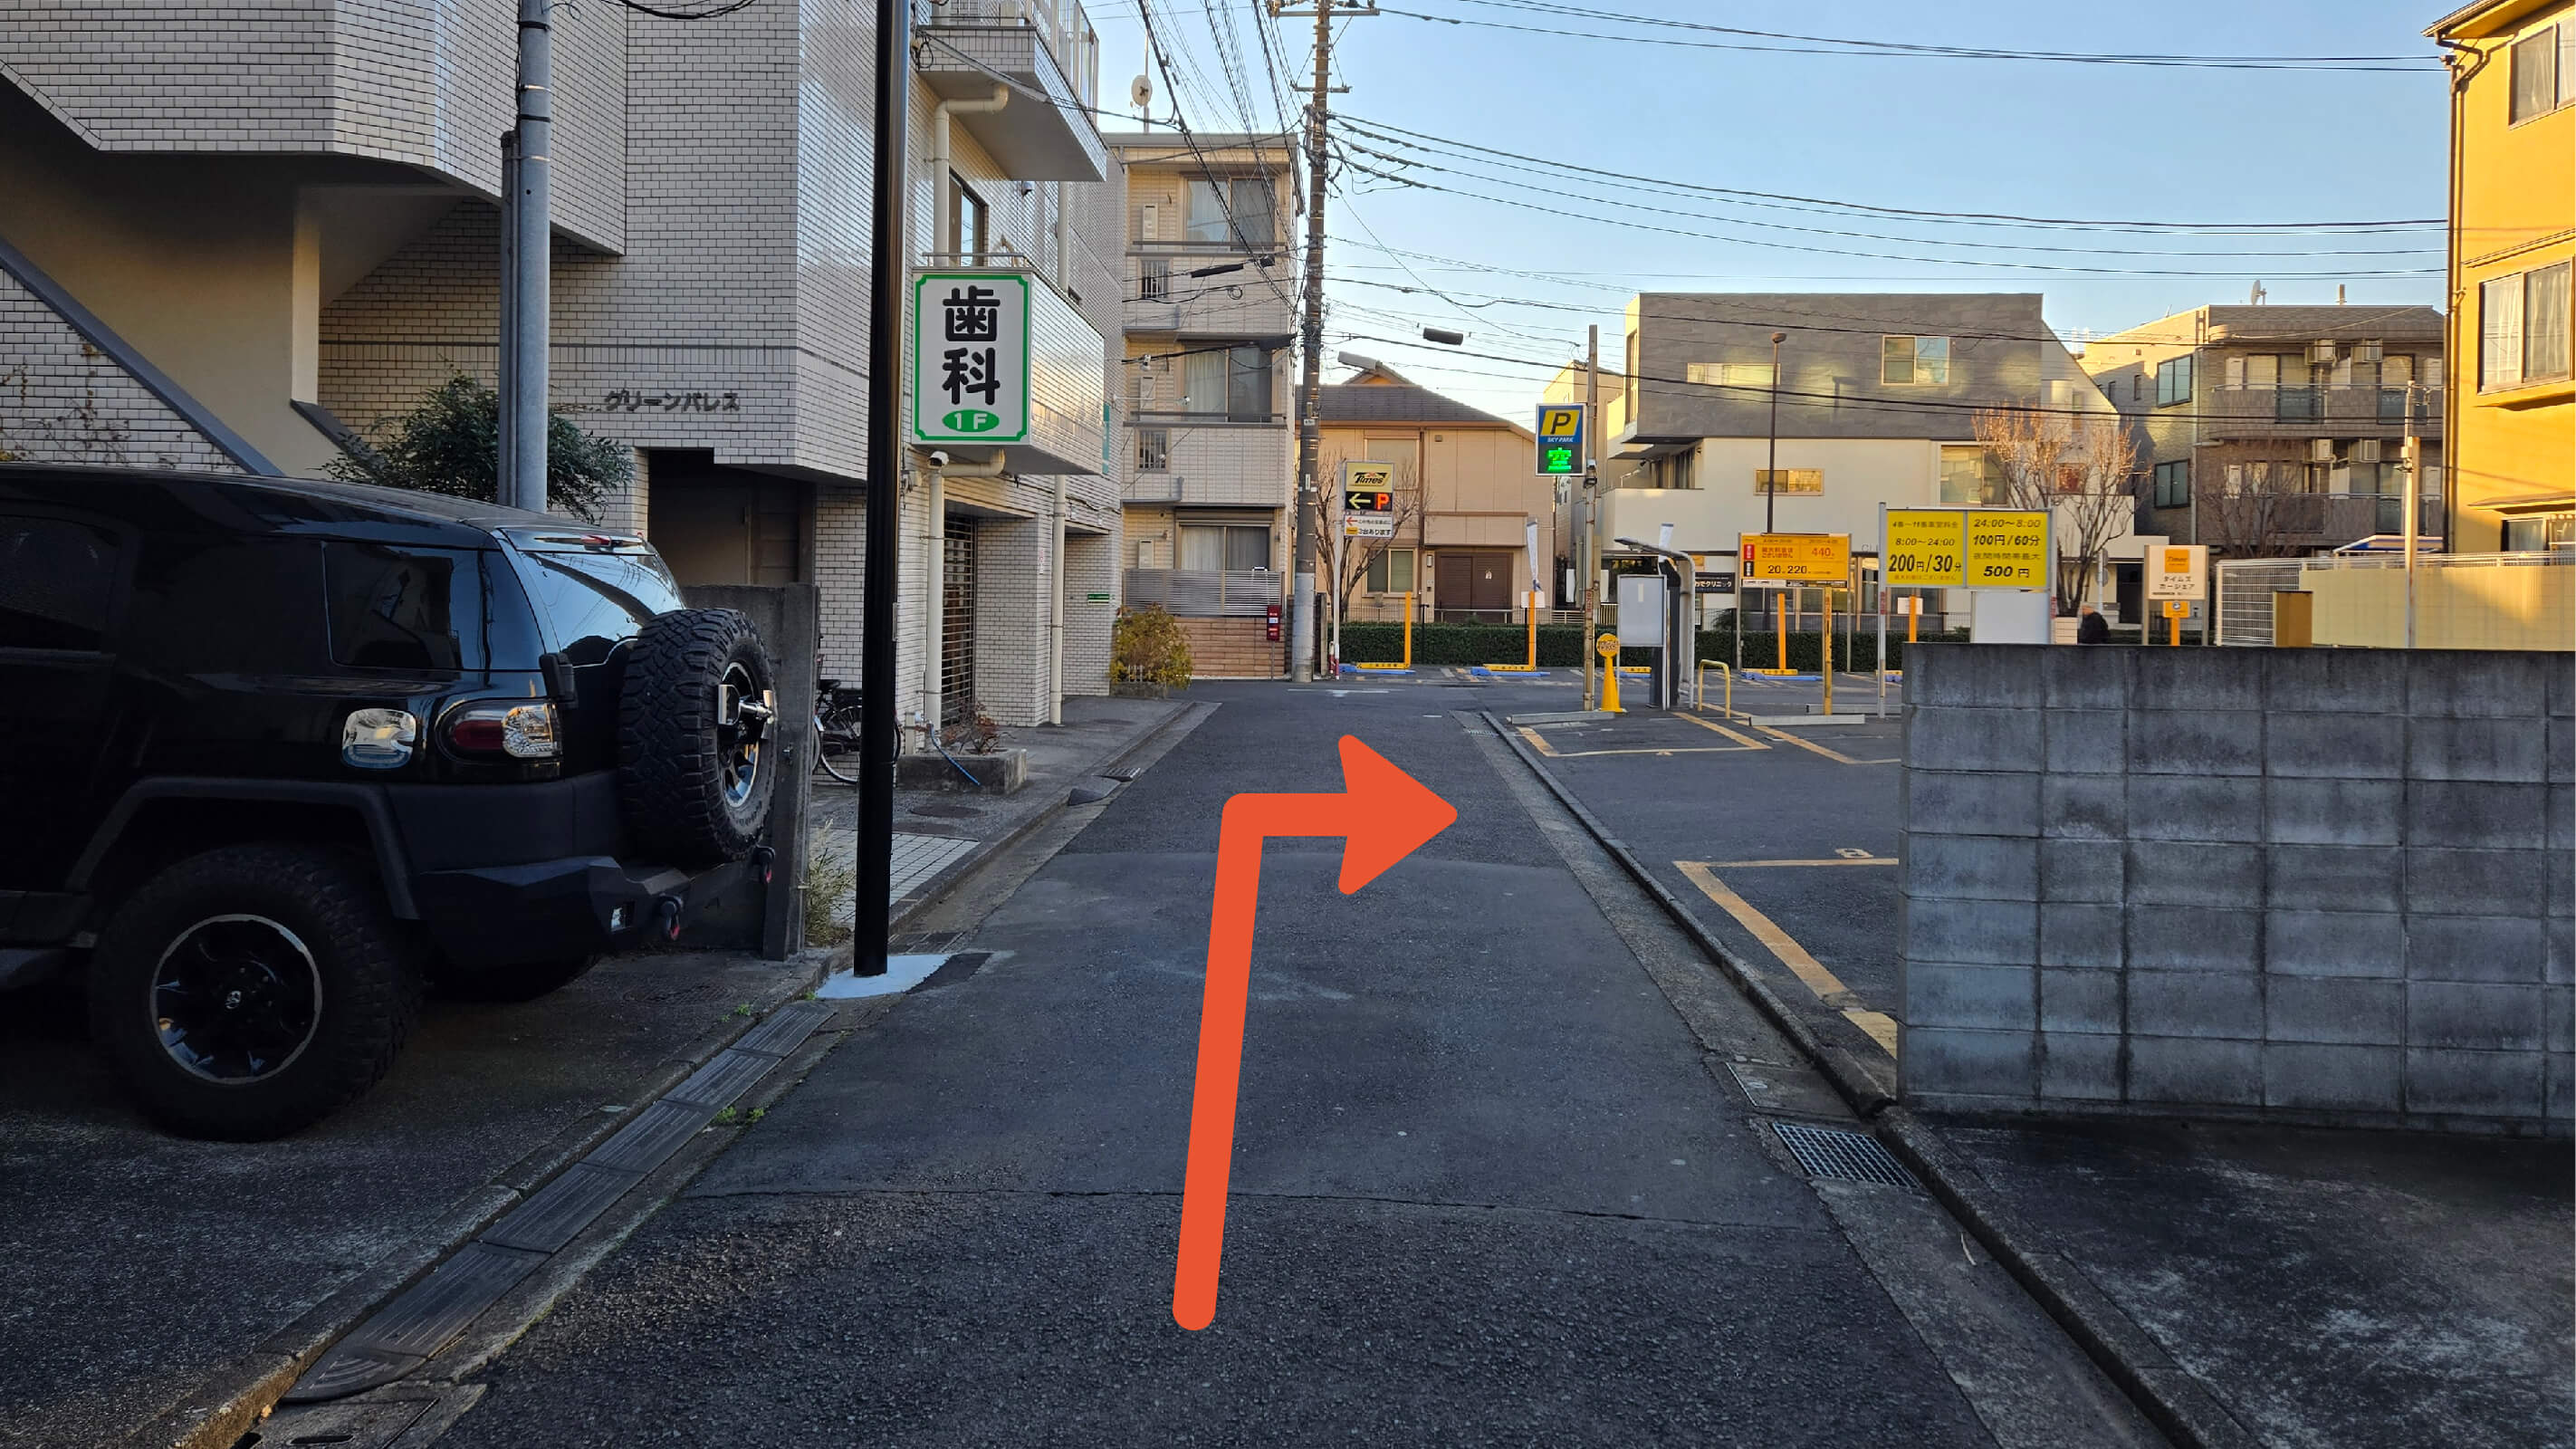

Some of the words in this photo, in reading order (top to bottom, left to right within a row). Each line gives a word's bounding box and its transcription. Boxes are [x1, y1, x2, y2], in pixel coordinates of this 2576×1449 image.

[942, 285, 1001, 406] 歯科
[1550, 412, 1572, 435] P
[1547, 446, 1572, 471] 空
[1354, 472, 1388, 485] Times
[1376, 493, 1390, 511] P
[1973, 534, 2041, 546] 100円/60分
[1888, 553, 1962, 572] 200円/30分
